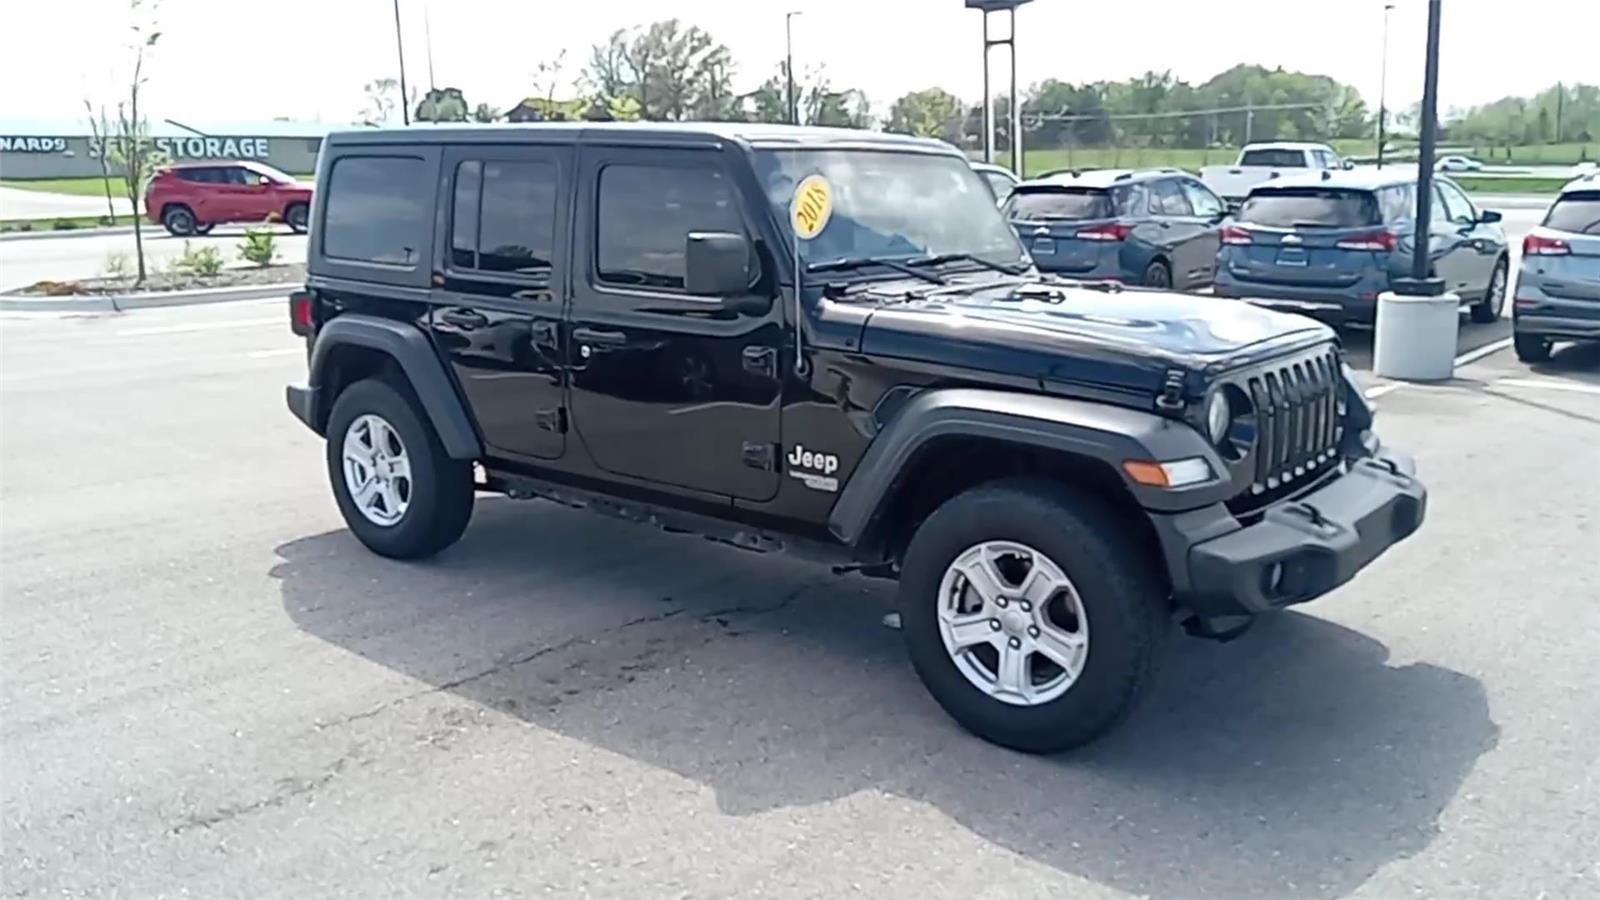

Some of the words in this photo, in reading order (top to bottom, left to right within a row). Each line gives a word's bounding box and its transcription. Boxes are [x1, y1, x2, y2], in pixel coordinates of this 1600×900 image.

[156, 138, 269, 158] STORAGE
[796, 183, 827, 232] 2018
[787, 444, 839, 475] Jeep
